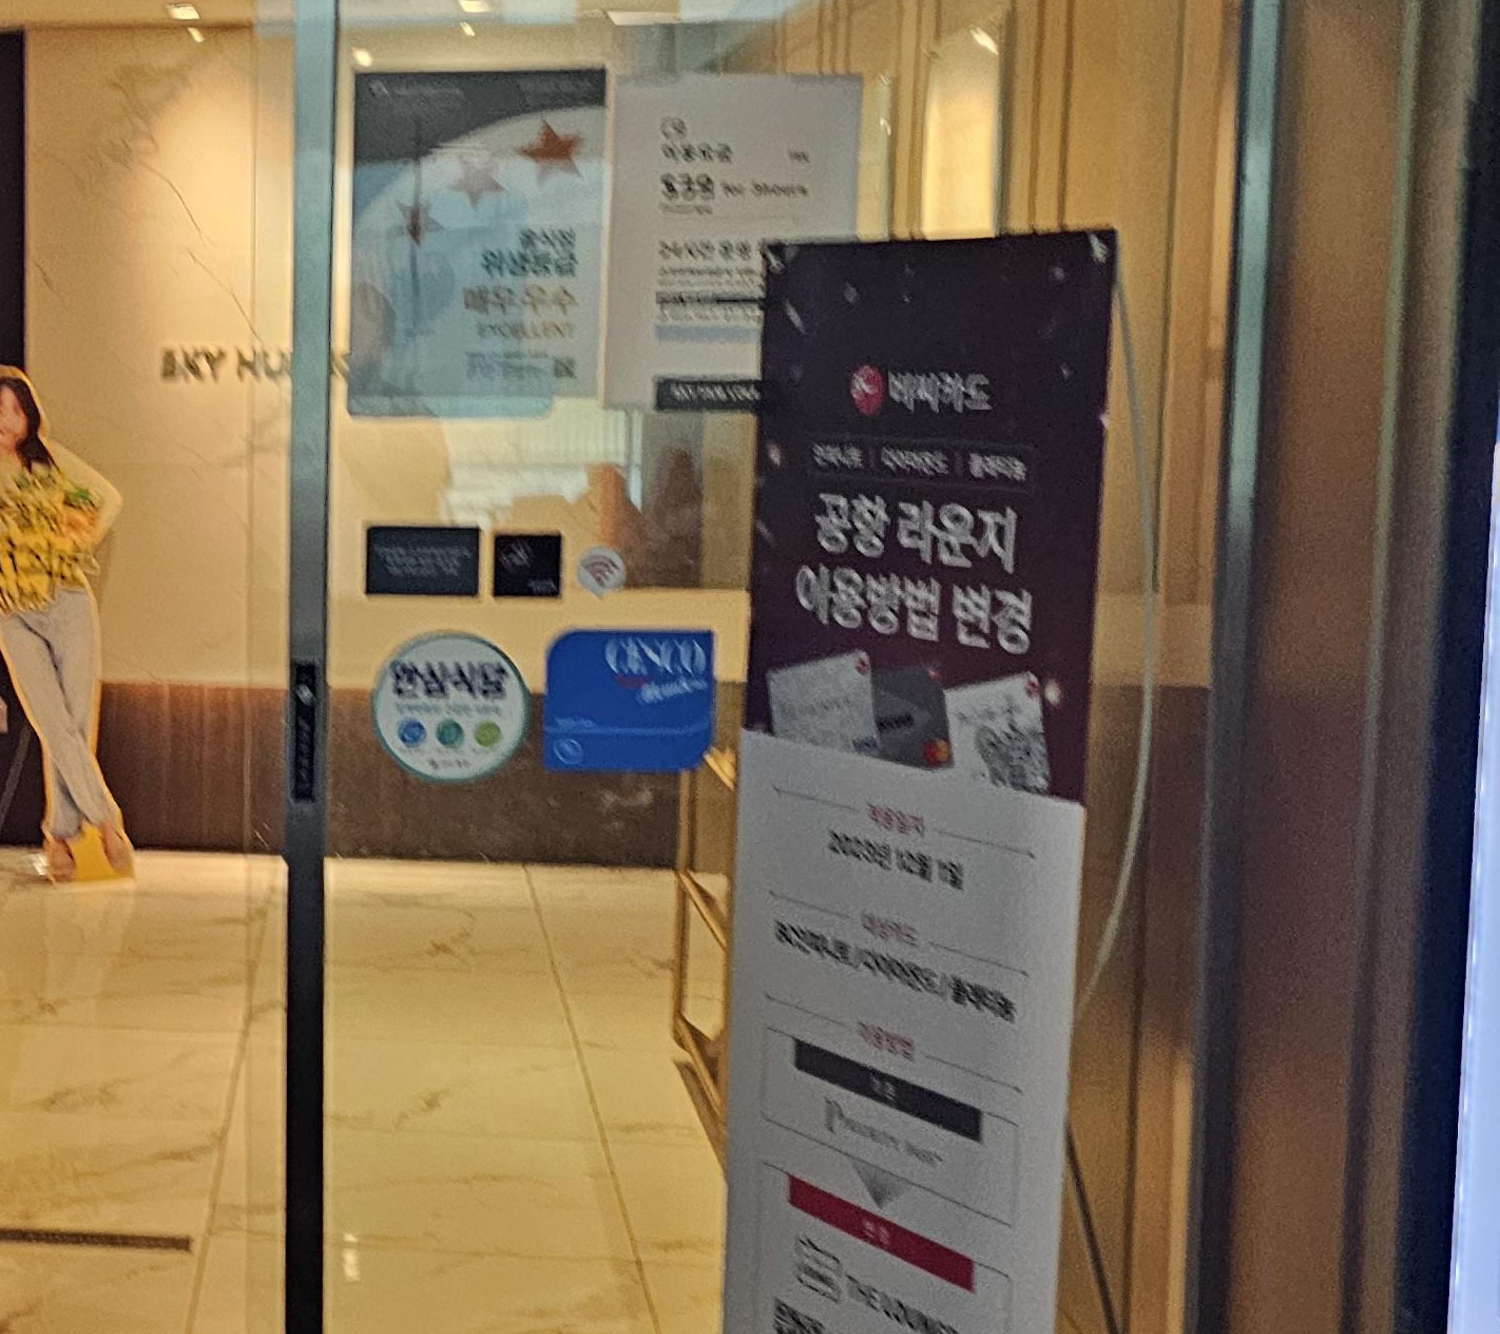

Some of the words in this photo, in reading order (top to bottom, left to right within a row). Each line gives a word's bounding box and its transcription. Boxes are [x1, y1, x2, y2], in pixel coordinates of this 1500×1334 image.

[813, 492, 891, 558] 공항
[896, 499, 1018, 576] 라운지
[794, 562, 942, 643] 이용방법
[952, 583, 1034, 656] 변경
